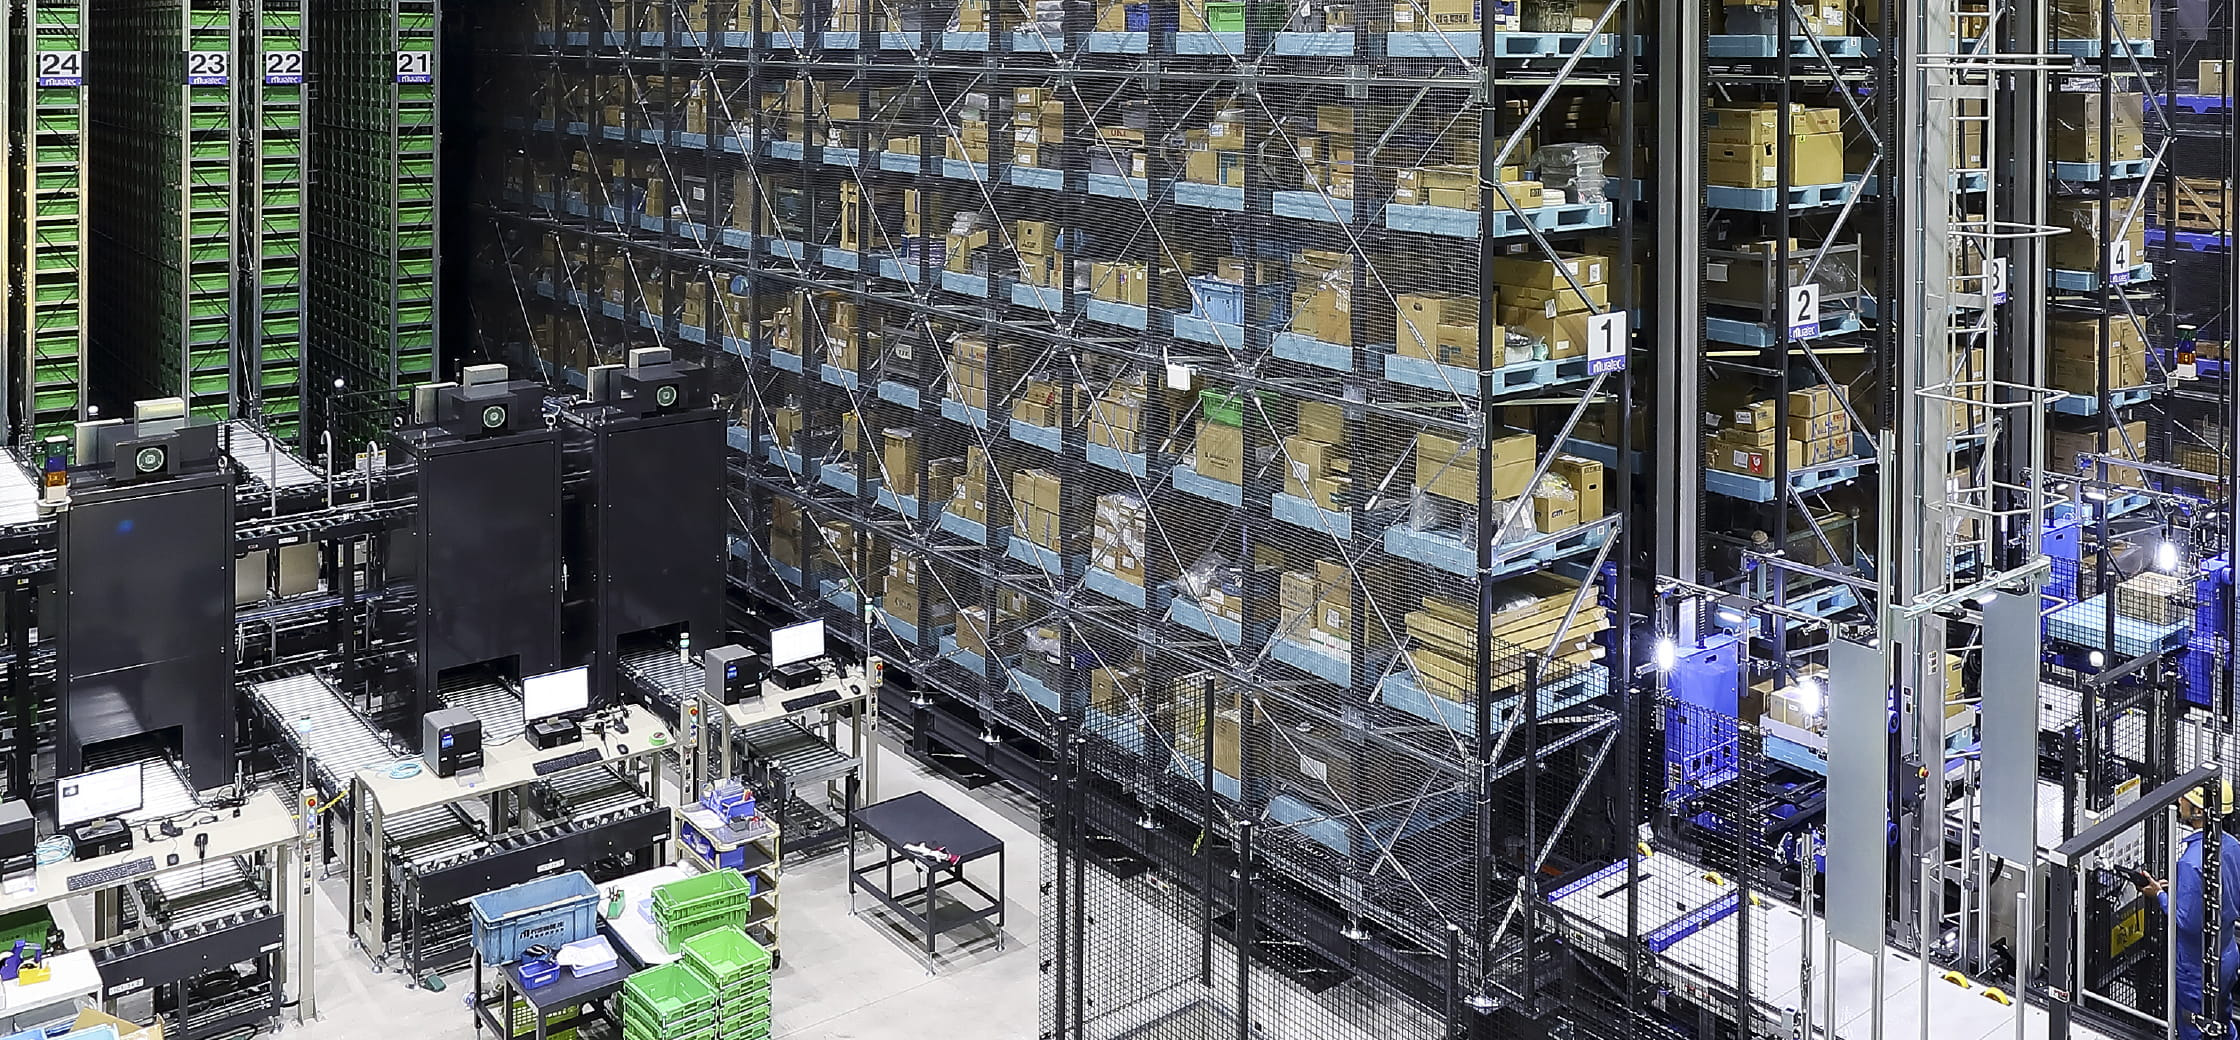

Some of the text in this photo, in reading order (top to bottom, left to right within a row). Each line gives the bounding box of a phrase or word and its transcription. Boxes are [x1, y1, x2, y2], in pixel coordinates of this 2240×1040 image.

[42, 54, 80, 75] 24
[190, 54, 225, 75] 23
[268, 53, 301, 73] 22
[398, 53, 427, 73] 21
[2115, 244, 2126, 269] 4
[1797, 289, 1811, 322] 2
[1600, 318, 1612, 353] 1
